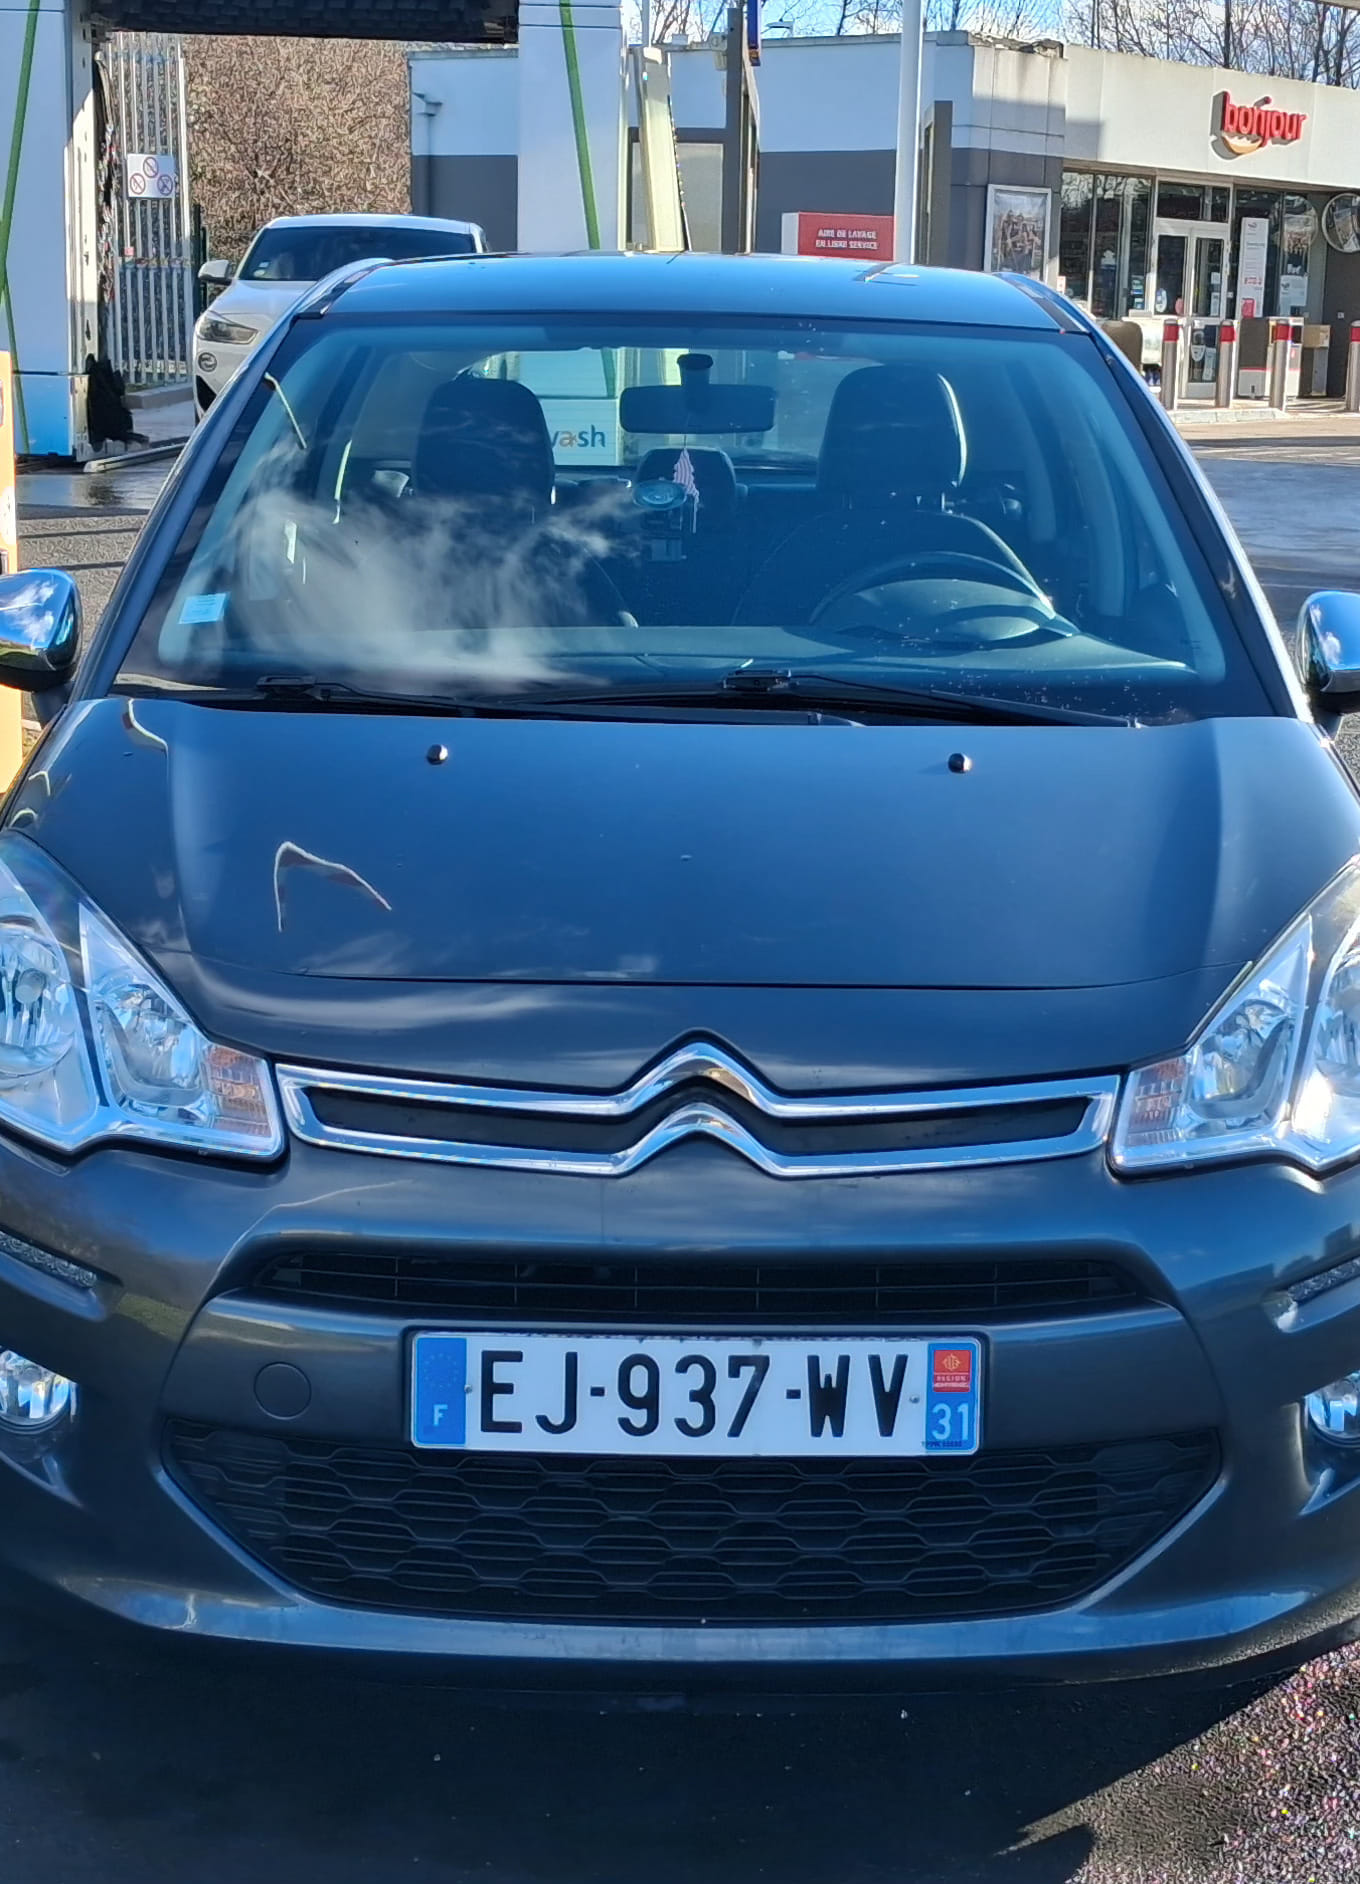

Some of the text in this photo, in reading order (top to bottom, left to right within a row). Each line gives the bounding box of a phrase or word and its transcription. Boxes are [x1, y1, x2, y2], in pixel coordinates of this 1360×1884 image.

[1220, 91, 1307, 148] bonjour
[433, 1404, 448, 1427] F
[481, 1350, 909, 1437] EJ-937-WV
[932, 1403, 969, 1440] 31
